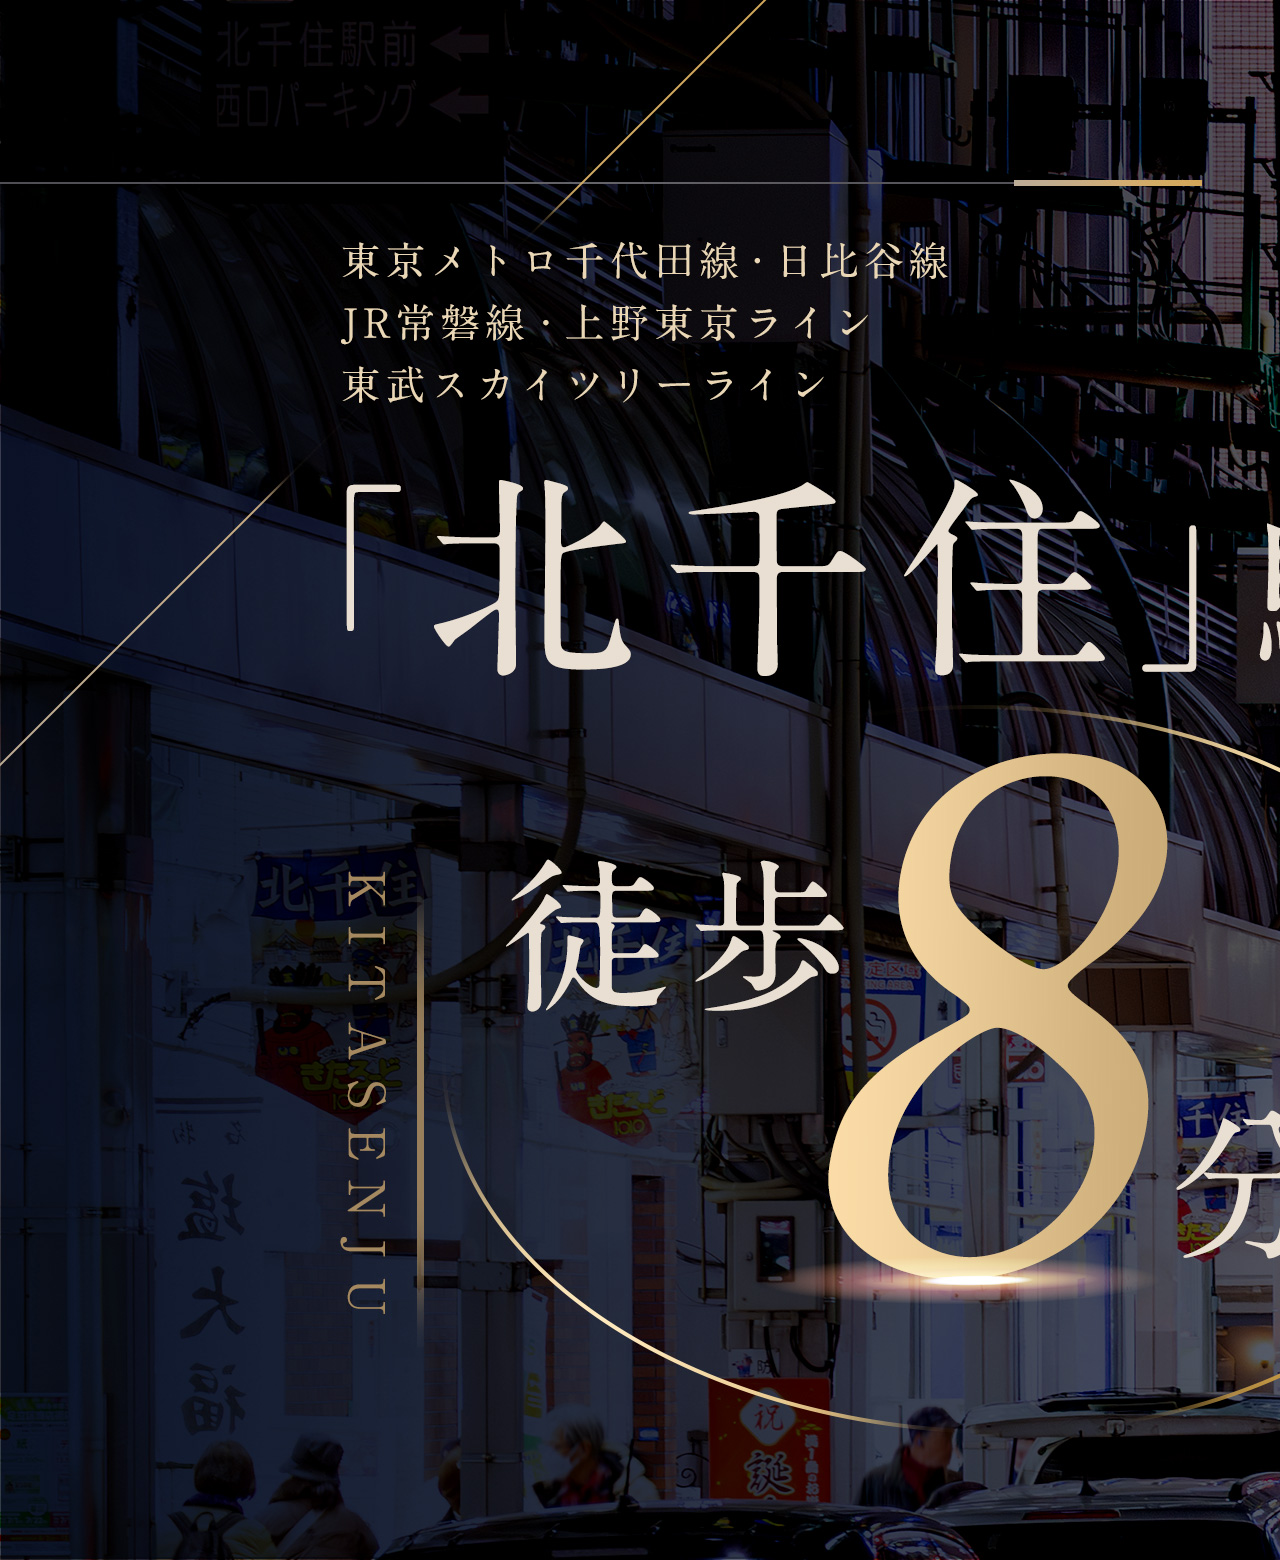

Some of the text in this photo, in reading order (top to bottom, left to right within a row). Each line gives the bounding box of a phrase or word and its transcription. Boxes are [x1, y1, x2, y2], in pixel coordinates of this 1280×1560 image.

[216, 20, 417, 68] 北千住駅前
[215, 82, 417, 129] 西口パーキング
[257, 860, 418, 916] 北千住
[1183, 1101, 1252, 1136] 千住
[754, 1404, 784, 1431] 祝
[746, 1451, 793, 1500] 誕
